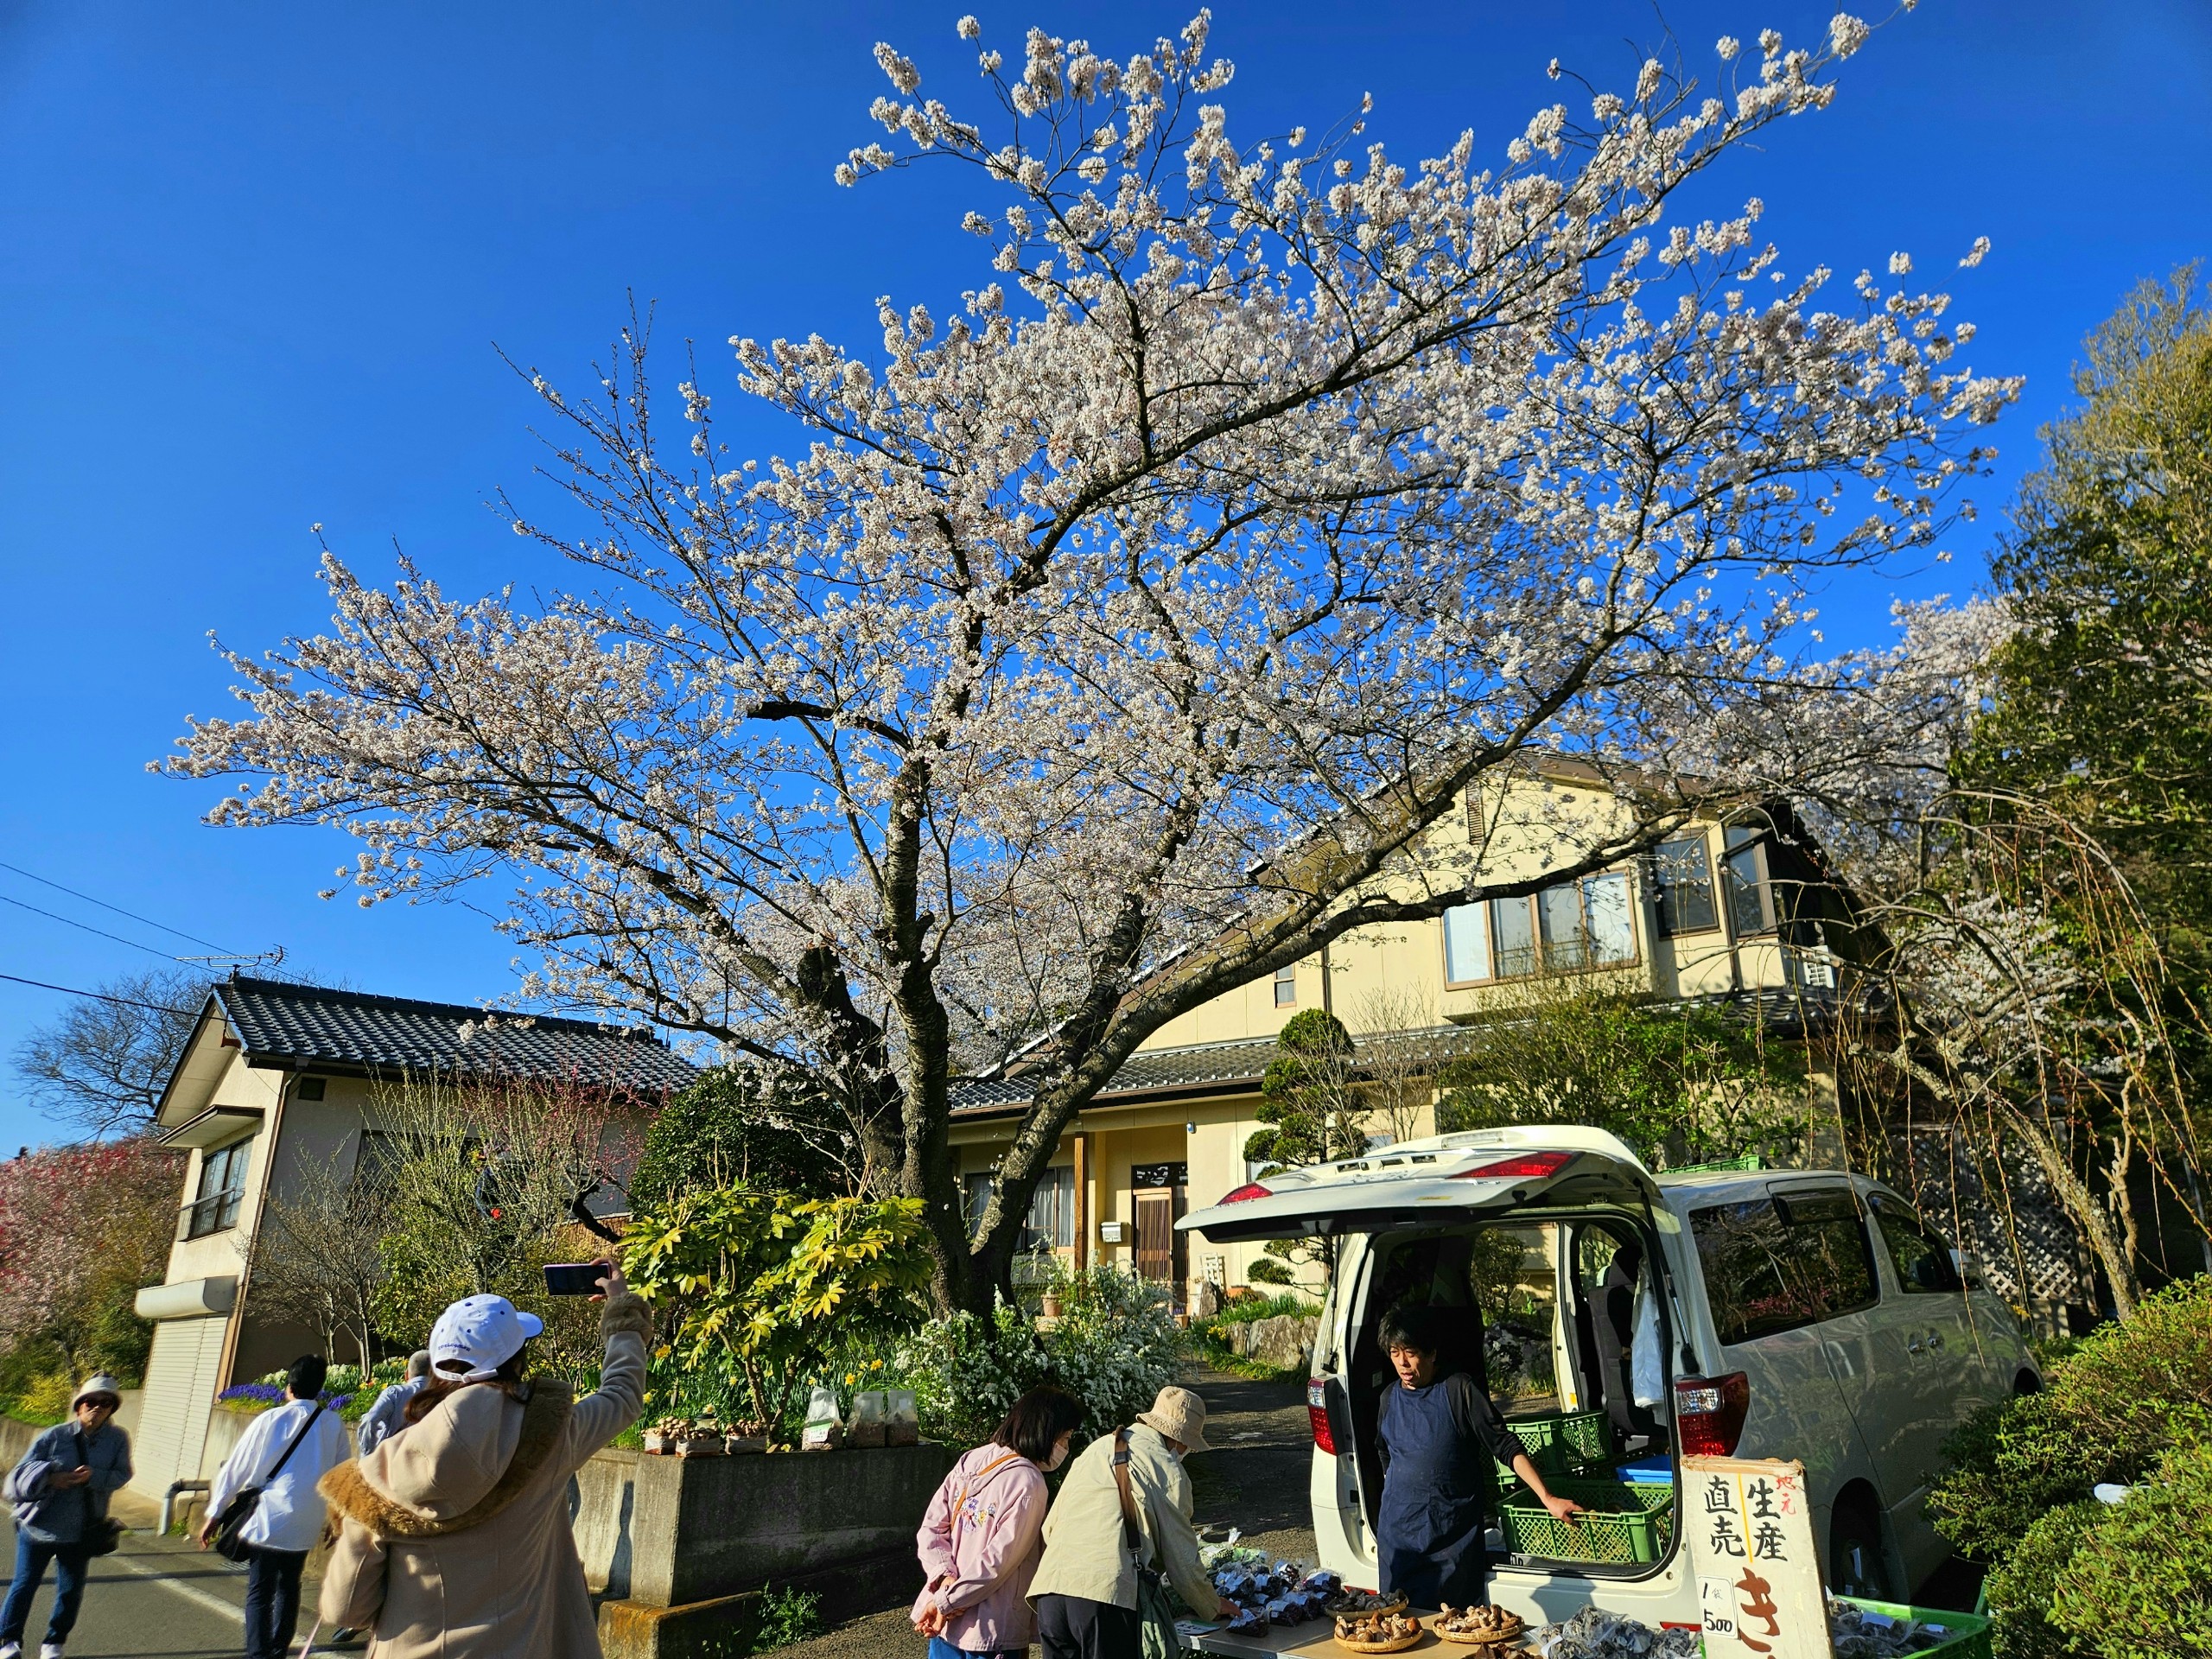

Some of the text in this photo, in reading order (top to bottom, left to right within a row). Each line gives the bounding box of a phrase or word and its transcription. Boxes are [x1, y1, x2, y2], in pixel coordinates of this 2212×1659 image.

[1704, 1475, 1746, 1556] 直売
[1747, 1478, 1788, 1561] 生産
[1776, 1476, 1796, 1515] 地元
[1703, 1608, 1733, 1632] 500
